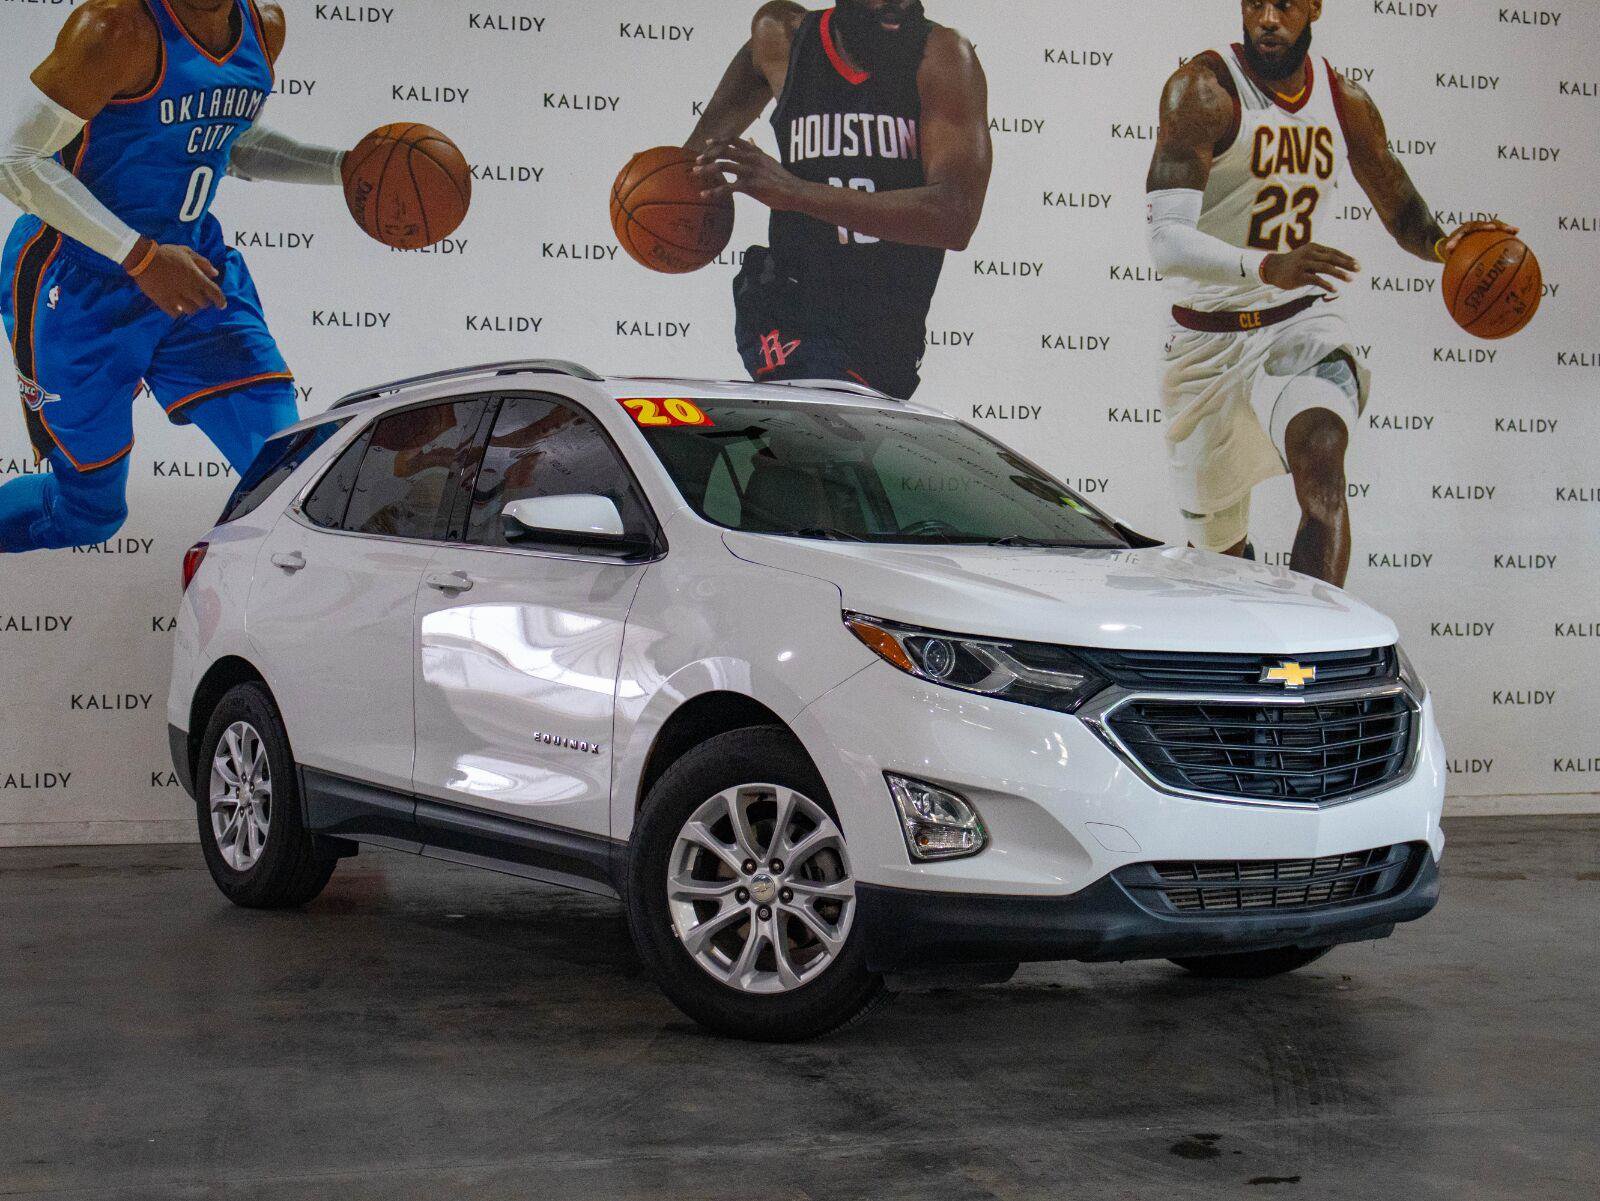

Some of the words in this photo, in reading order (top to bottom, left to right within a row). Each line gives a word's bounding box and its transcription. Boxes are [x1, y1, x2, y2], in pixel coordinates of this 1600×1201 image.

[316, 5, 393, 23] KALIDY
[1375, 0, 1437, 17] KALIDY
[470, 14, 545, 32] KALIDY
[1500, 9, 1561, 25] KALIDY
[621, 23, 693, 41] KALIDY
[1045, 49, 1112, 66] KALIDY
[271, 79, 316, 96] IDY
[1437, 73, 1499, 89] KALIDY
[1559, 81, 1598, 97] KALI
[393, 85, 469, 103] KALIDY
[544, 93, 619, 111] KALIDY
[160, 88, 263, 125] OKLAHOM
[988, 118, 1045, 134] ALIDY
[1112, 124, 1160, 140] KALI
[187, 125, 235, 154] CITY
[790, 112, 917, 163] HOUSTON
[1251, 125, 1334, 181] CAVS
[1387, 140, 1437, 155] ALIDY
[1498, 146, 1559, 161] KALIDY
[470, 165, 543, 182] KALIDY
[178, 165, 214, 223] 0
[1044, 192, 1111, 208] KALIDY
[1246, 184, 1320, 253] 23
[1559, 217, 1600, 232] KALI
[236, 232, 313, 248] KALIDY
[543, 243, 617, 260] KALIDY
[975, 261, 1042, 276] KALIDY
[1372, 277, 1434, 292] KALIDY
[313, 311, 390, 327] KALIDY
[467, 316, 542, 332] KALIDY
[1238, 311, 1261, 329] CLE
[617, 321, 690, 337] KALIDY
[924, 331, 974, 347] LIDY
[1042, 335, 1109, 350] KALIDY
[1434, 348, 1496, 363] KALIDY
[1557, 352, 1600, 367] KALI
[622, 398, 706, 426] 20
[973, 405, 1041, 419] KALIDY
[1108, 408, 1162, 423] KALID
[1370, 415, 1433, 429] KALIDY
[1496, 418, 1557, 432] KALIDY
[0, 458, 52, 474] ALI
[154, 462, 231, 477] KALIDY
[1433, 485, 1495, 499] KALIDY
[1556, 487, 1600, 502] KALI
[1369, 554, 1432, 567] KALIDY
[1495, 555, 1556, 568] KALIDY
[0, 616, 73, 632] ALIDY
[1431, 623, 1494, 636] KALIDY
[72, 694, 152, 709] KALIDY
[1493, 691, 1555, 704] KALIDY
[533, 732, 600, 754] EQUINOX
[0, 773, 72, 789] ALIDY
